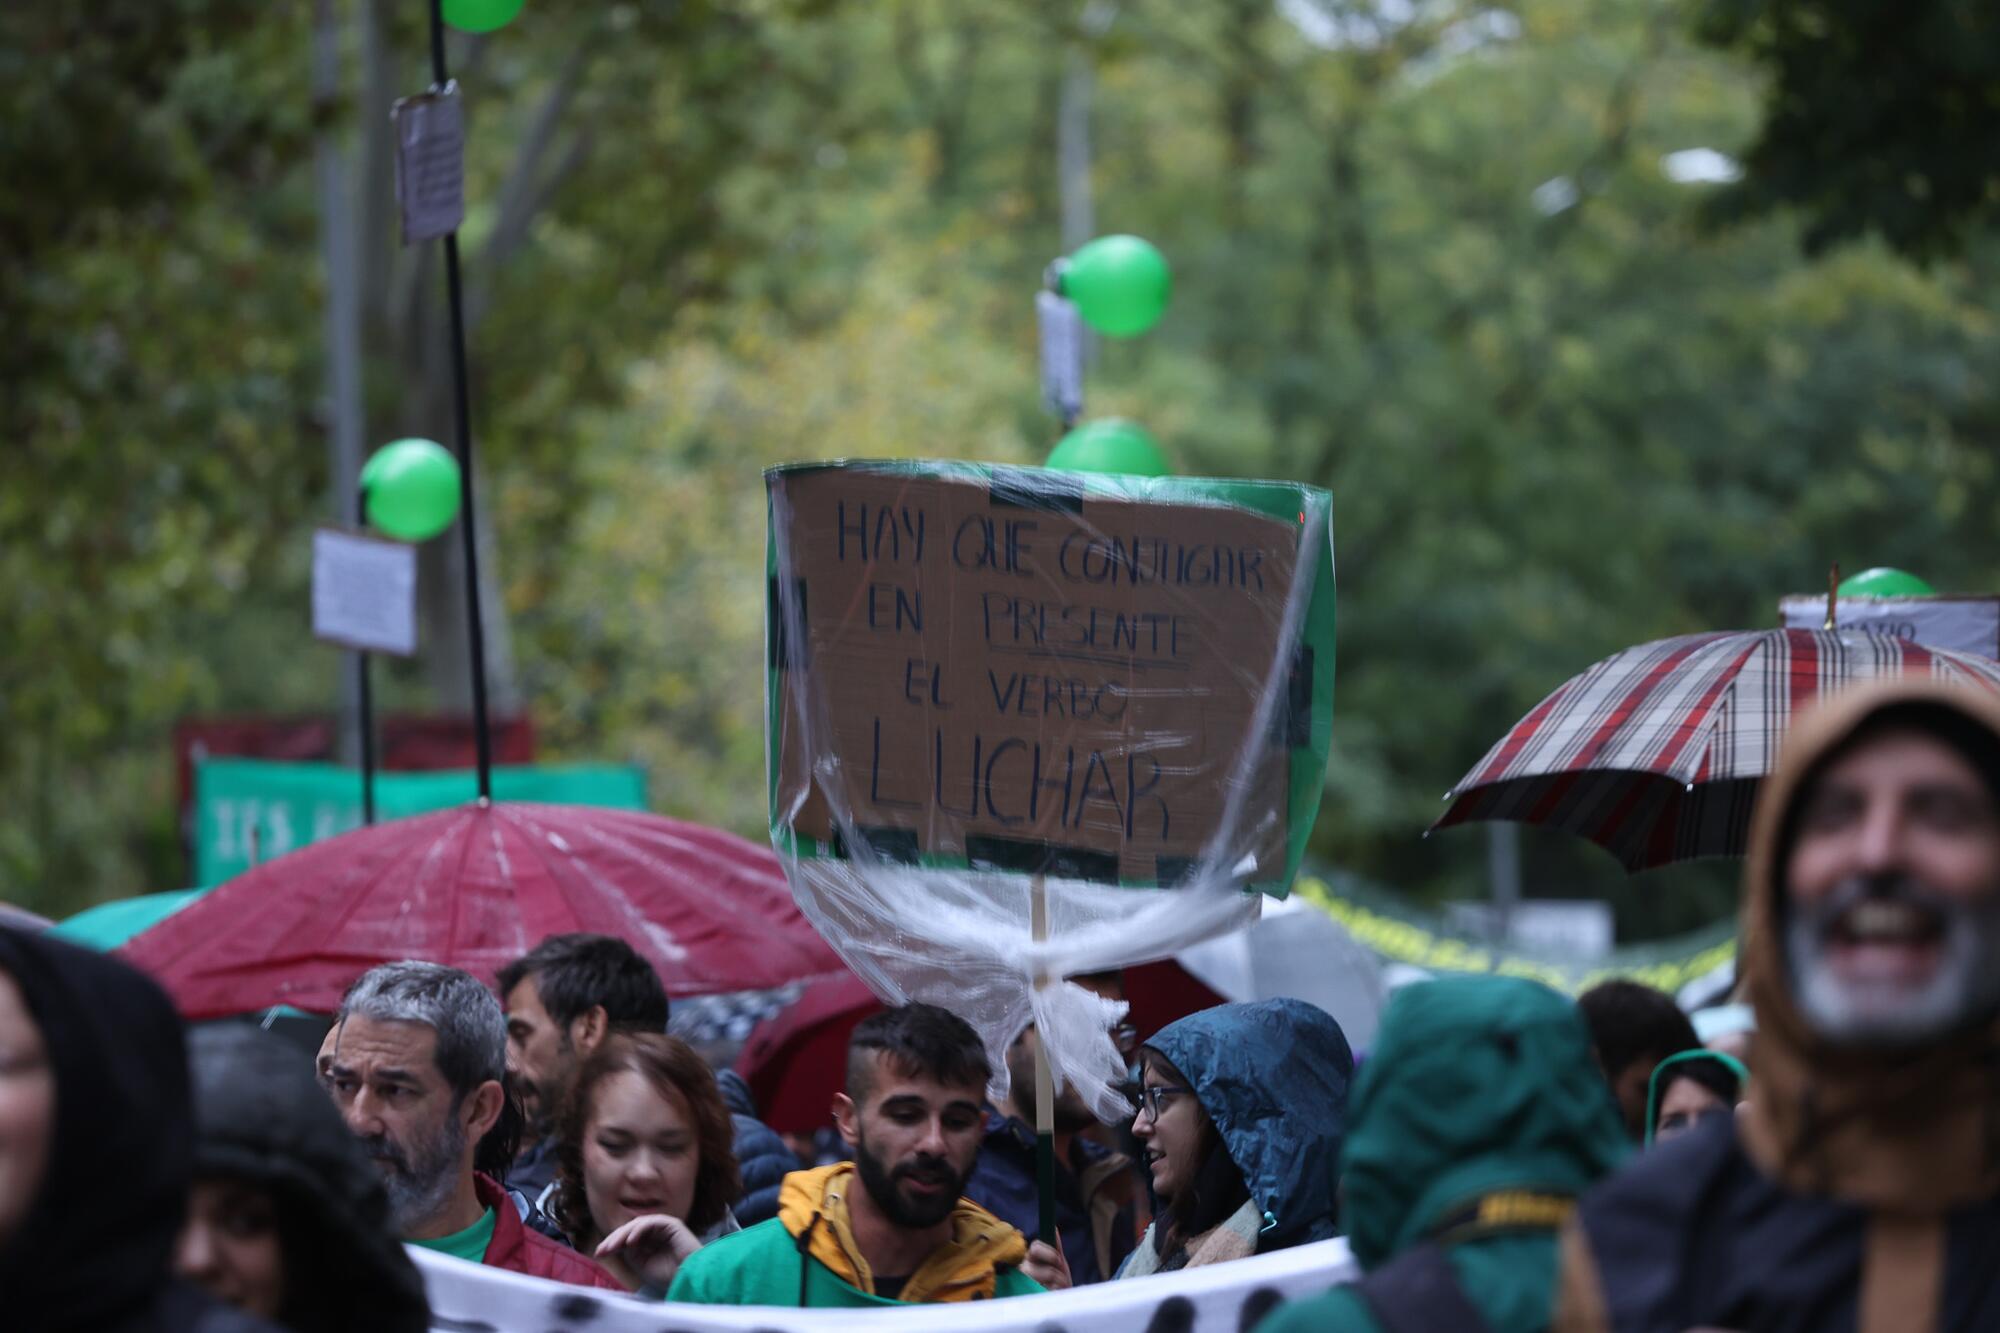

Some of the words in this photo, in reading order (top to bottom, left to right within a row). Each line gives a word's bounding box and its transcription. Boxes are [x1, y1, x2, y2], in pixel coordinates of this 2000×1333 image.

[837, 502, 925, 562] HAY
[953, 513, 1037, 577] QUE
[1059, 531, 1264, 591] CONJUGAR
[869, 585, 922, 634] EN
[983, 591, 1190, 657] PRESENTE
[905, 659, 953, 709] EL
[989, 668, 1128, 721] VERBO
[871, 718, 1169, 842] LUCHAR
